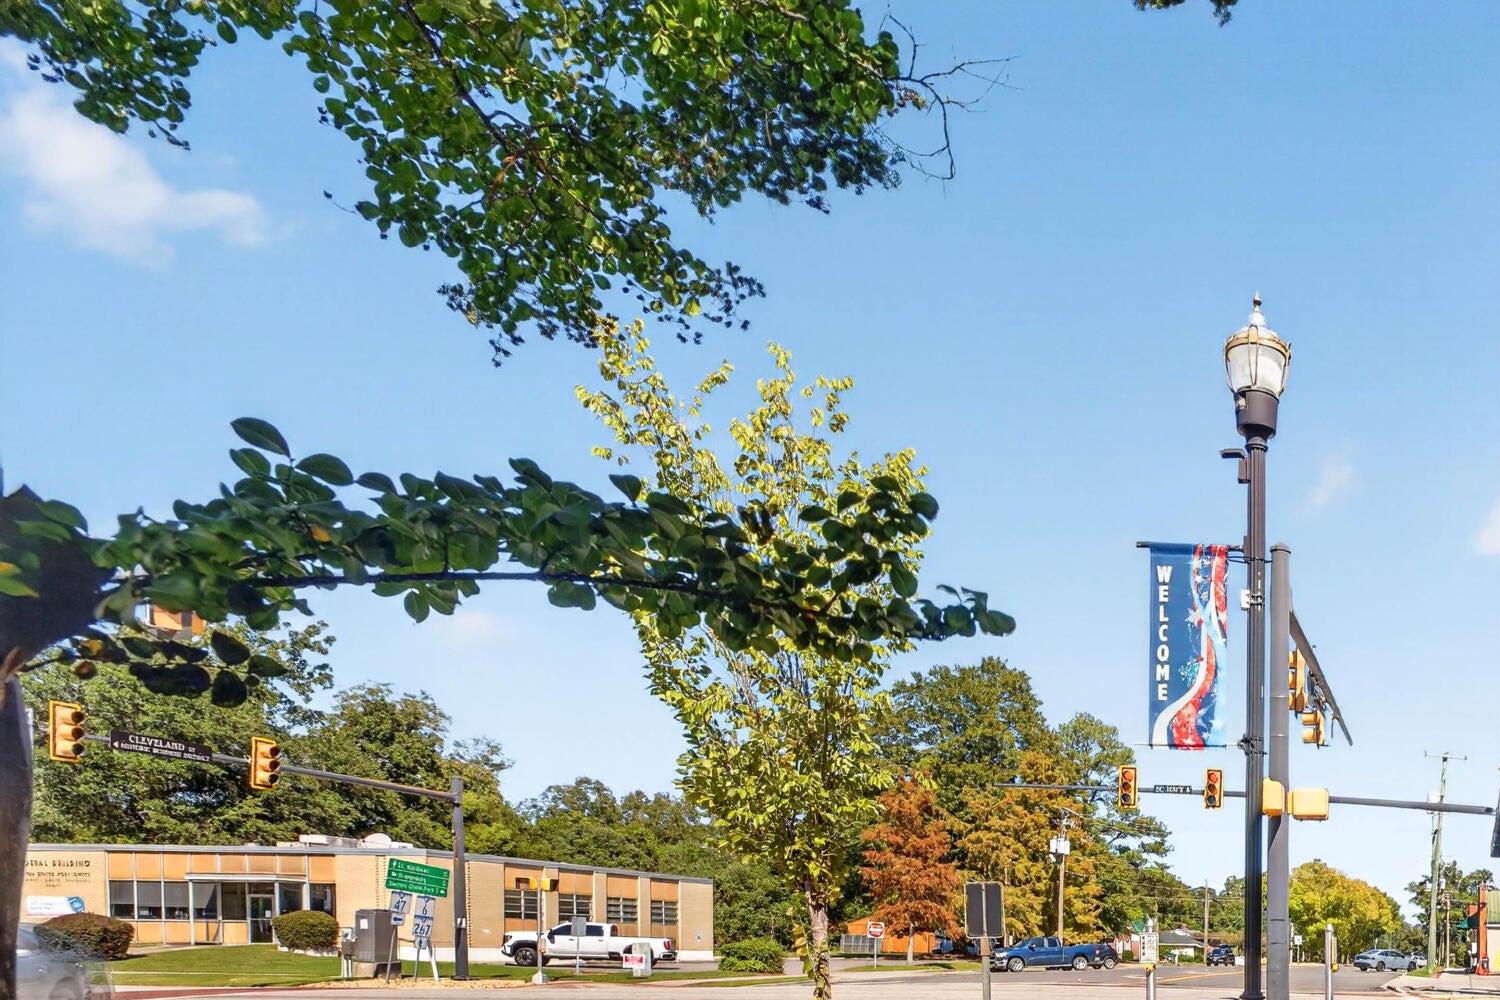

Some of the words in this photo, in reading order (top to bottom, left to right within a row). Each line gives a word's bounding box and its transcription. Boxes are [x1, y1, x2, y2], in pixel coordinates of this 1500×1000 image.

[1156, 565, 1172, 701] WELCOME
[129, 735, 185, 751] CLEVELAND
[394, 900, 407, 912] 47
[422, 904, 428, 915] 6
[414, 923, 431, 936] 267
